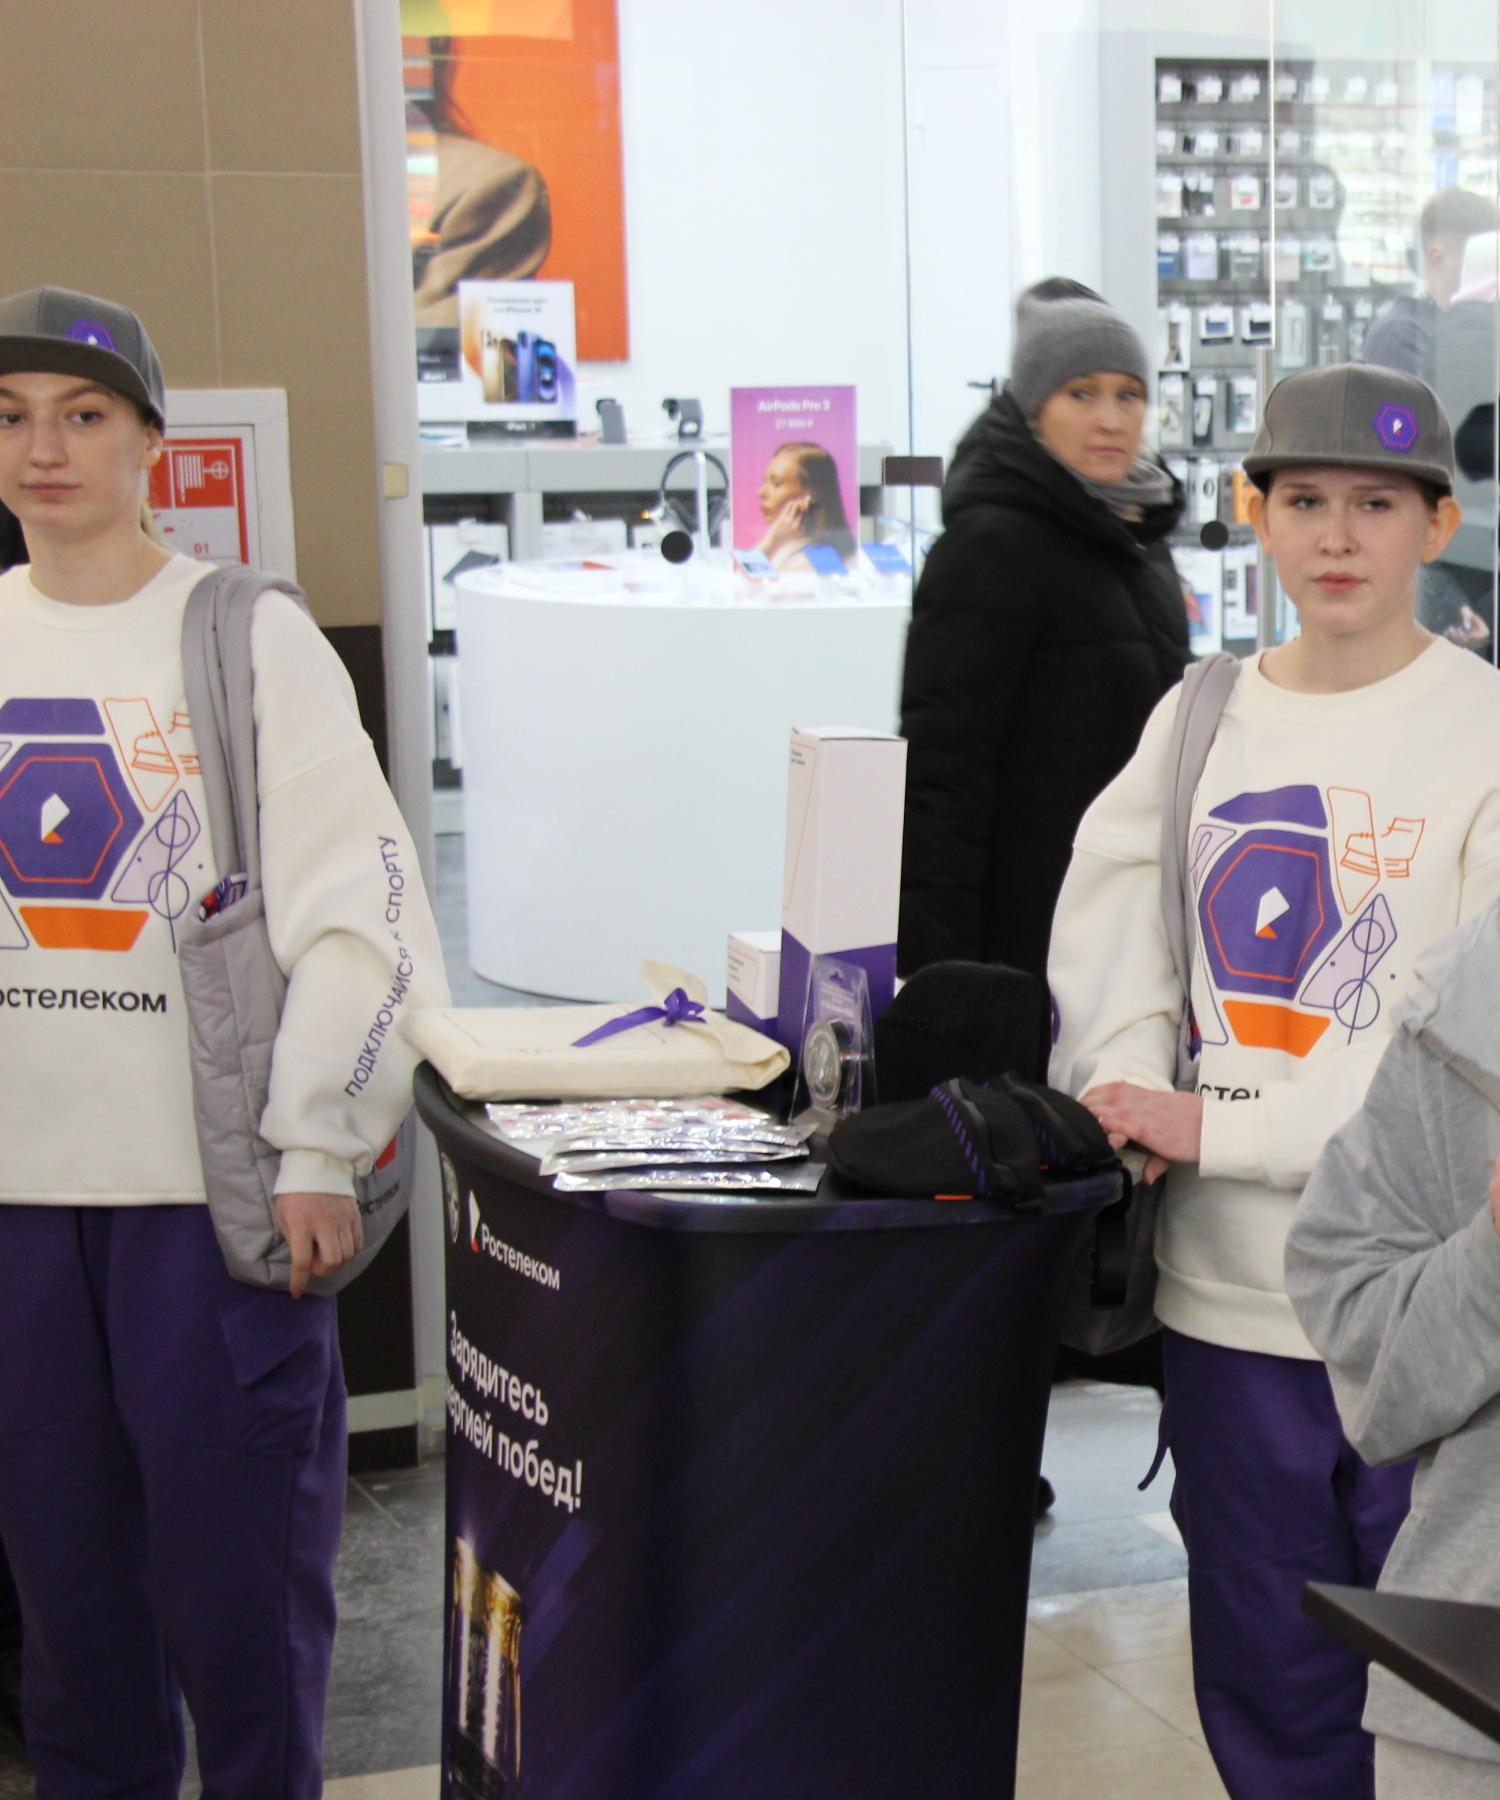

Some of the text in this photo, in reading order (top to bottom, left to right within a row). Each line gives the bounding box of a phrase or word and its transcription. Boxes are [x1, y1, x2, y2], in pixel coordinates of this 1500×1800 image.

[802, 399, 821, 411] Pro
[194, 543, 209, 555] 01
[377, 836, 405, 924] СПОРТУ
[0, 988, 167, 1013] стелеком
[481, 1222, 560, 1290] Ростелеком
[450, 1309, 549, 1426] Зарядитесь
[497, 1432, 583, 1514] побед!
